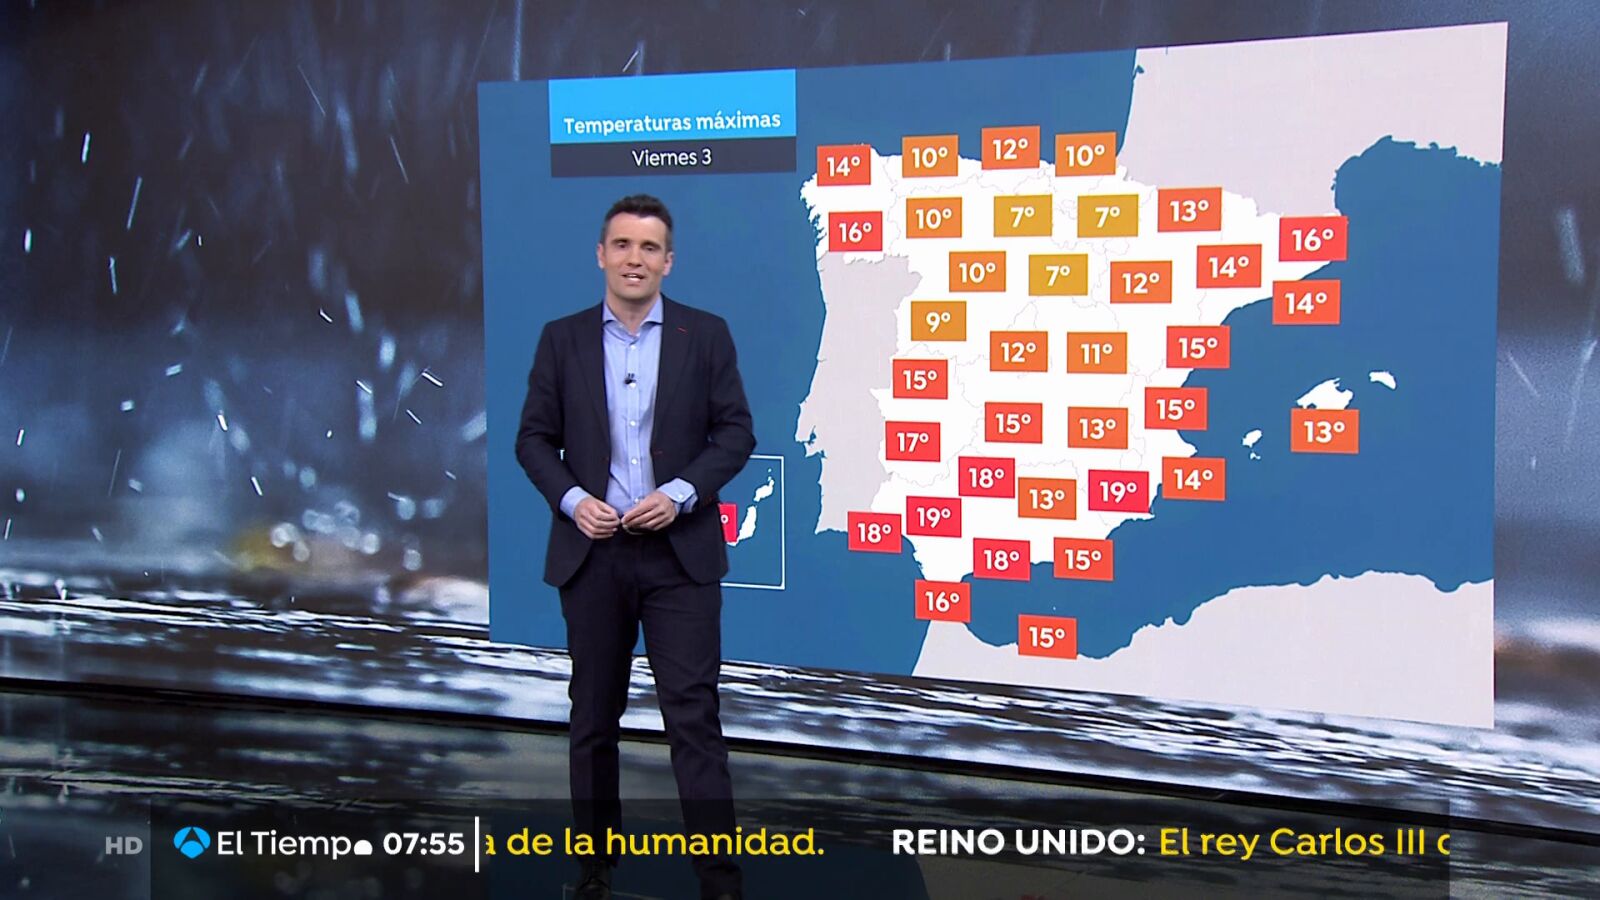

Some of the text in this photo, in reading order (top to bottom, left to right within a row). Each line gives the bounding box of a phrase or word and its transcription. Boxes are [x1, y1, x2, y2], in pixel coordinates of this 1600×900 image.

[563, 109, 782, 136] Temperaturas máximas
[631, 148, 713, 168] Viernes 3
